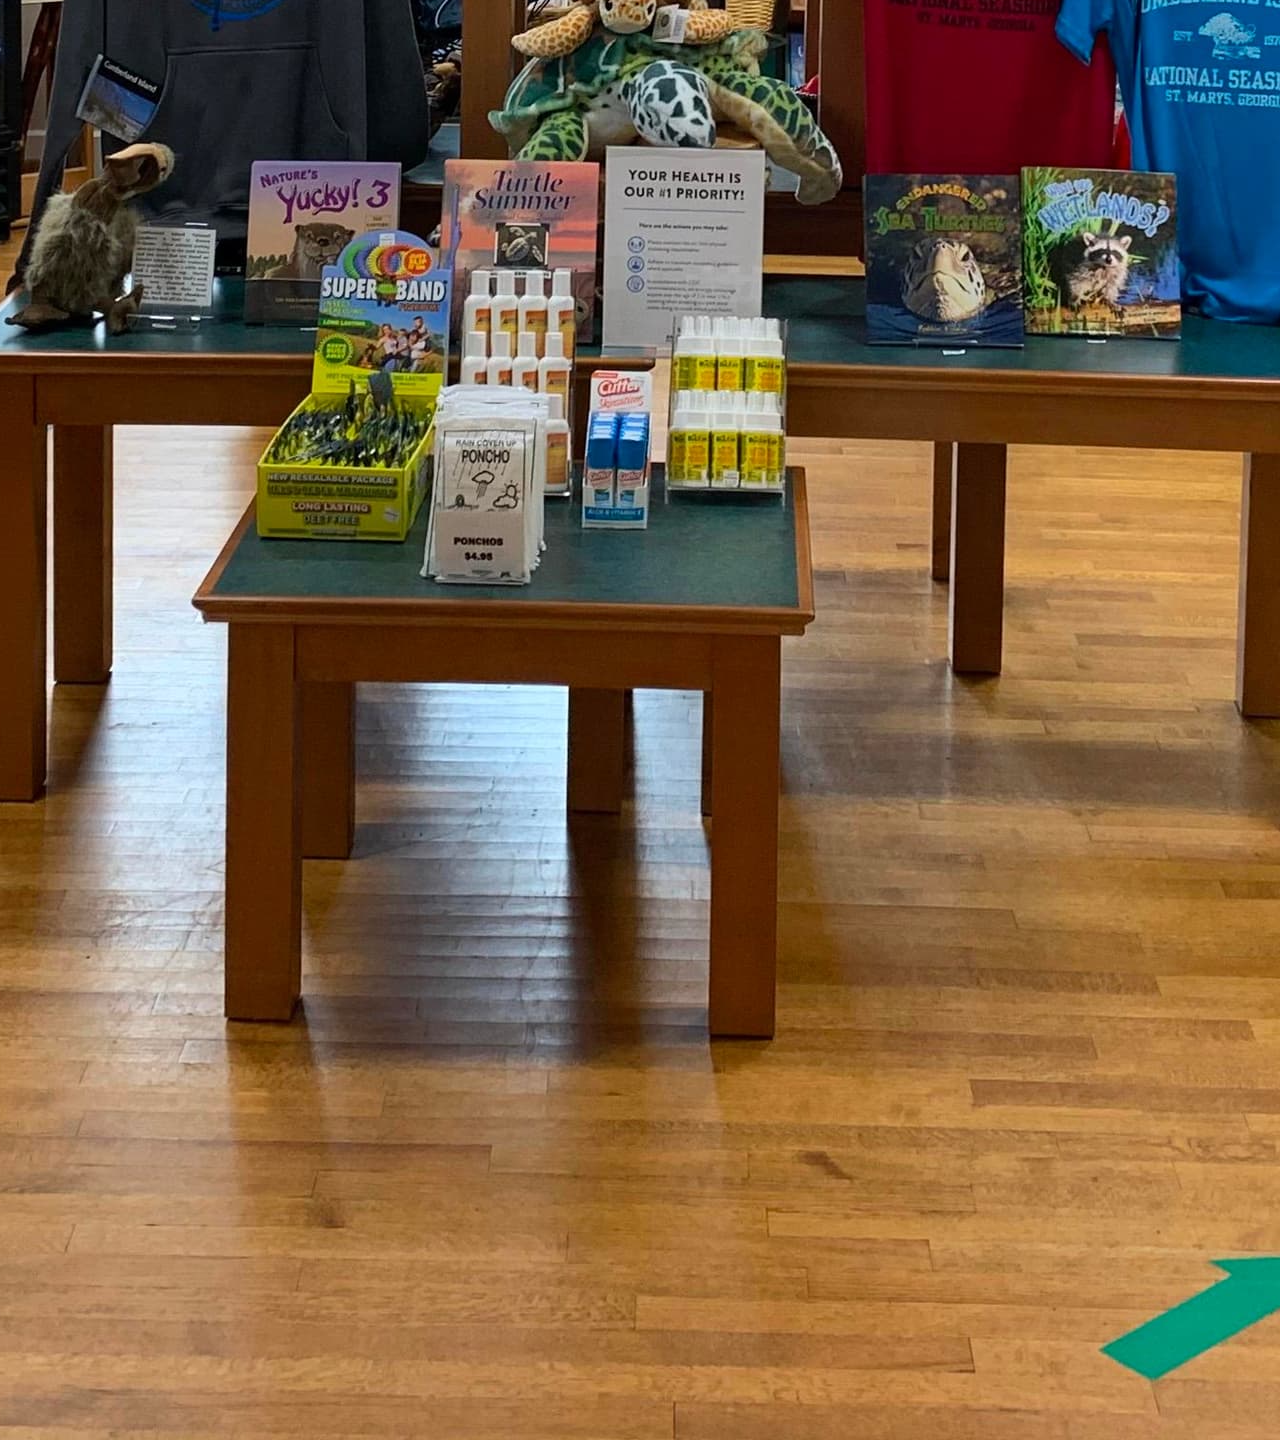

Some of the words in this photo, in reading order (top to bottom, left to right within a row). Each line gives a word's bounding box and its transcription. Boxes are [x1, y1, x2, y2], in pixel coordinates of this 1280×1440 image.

[137, 78, 158, 94] Island
[260, 169, 318, 188] NATURE'S
[494, 169, 563, 193] Turtle
[628, 169, 667, 182] YOUR
[672, 171, 724, 183] HEALTH
[729, 173, 741, 184] IS
[276, 178, 361, 224] Yucky!
[366, 179, 391, 208] 3
[473, 188, 576, 210] Summer
[624, 186, 654, 198] OUR
[659, 188, 671, 198] #1
[676, 187, 744, 201] PRIORITY!
[896, 183, 988, 211] ENDANGERED
[1037, 192, 1170, 238] WETLANDS?
[322, 277, 376, 300] SUPER
[395, 280, 446, 302] BAND
[461, 449, 510, 464] PONCHO
[267, 471, 287, 481] NEW
[351, 476, 395, 486] PACKAGE
[291, 501, 321, 511] LONG
[323, 503, 369, 513] LASTING
[453, 536, 504, 547] PONCHOS
[464, 551, 493, 561] $4.95
